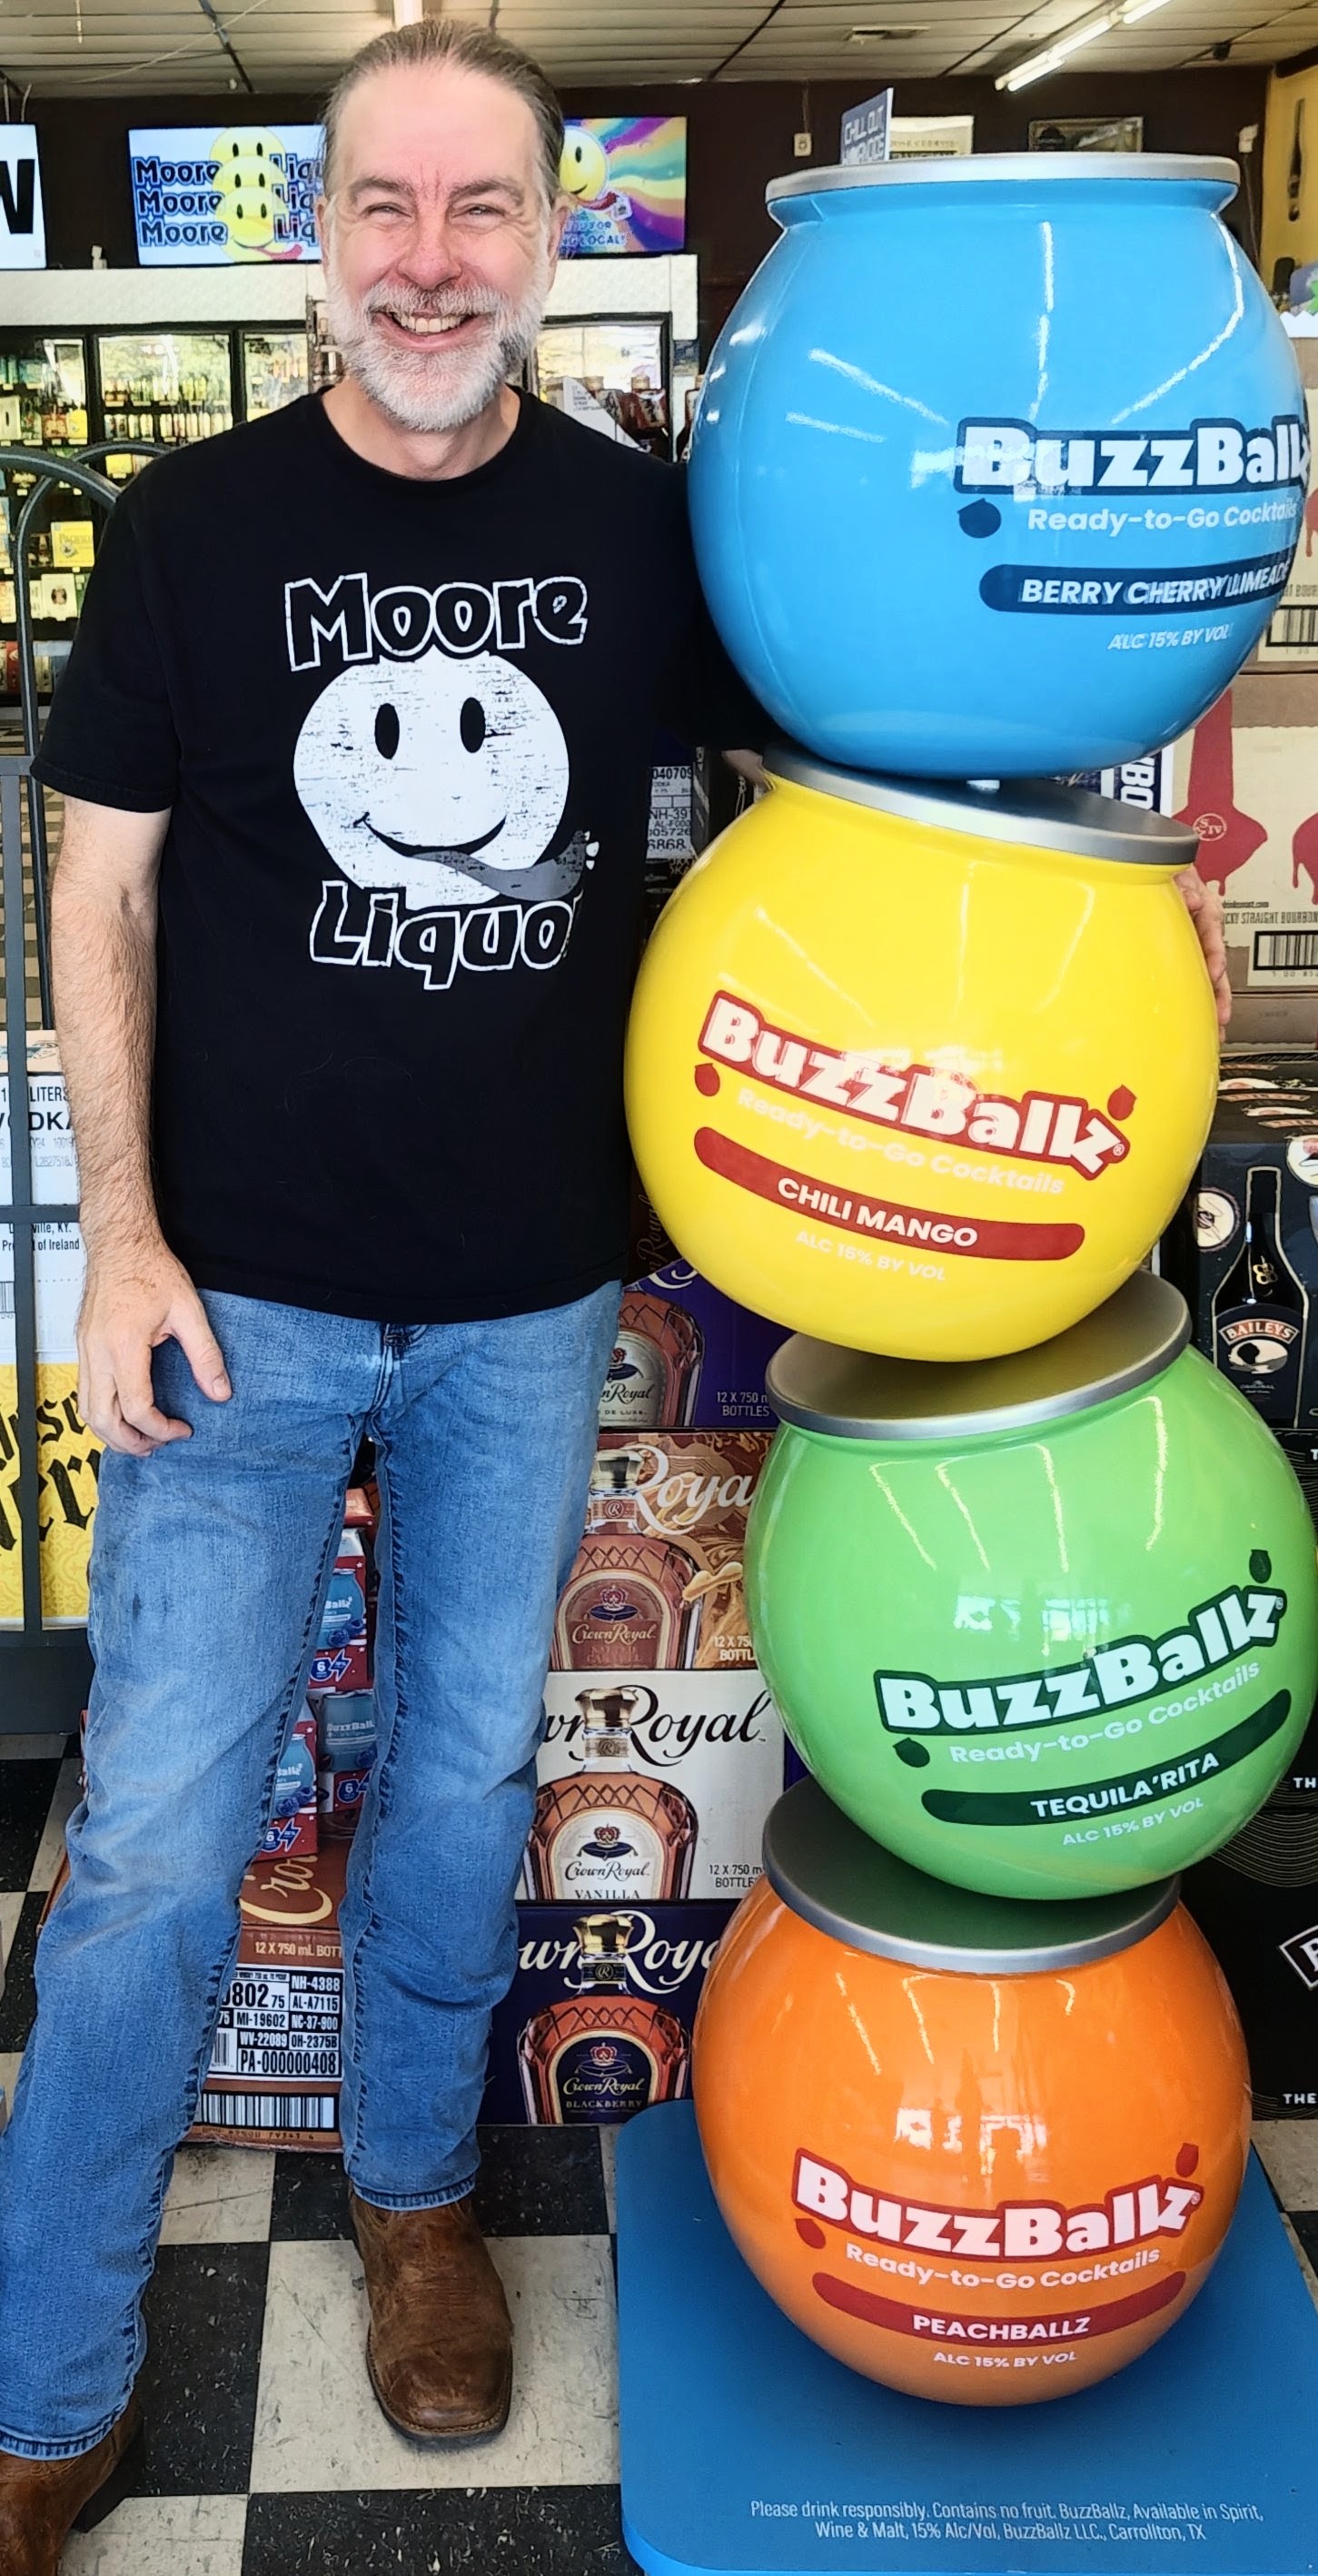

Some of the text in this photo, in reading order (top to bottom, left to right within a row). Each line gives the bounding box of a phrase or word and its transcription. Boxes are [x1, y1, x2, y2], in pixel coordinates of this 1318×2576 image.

[133, 156, 223, 186] Moore
[135, 187, 226, 217] Moore
[138, 221, 227, 247] Moore
[1027, 506, 1220, 537] Ready-to-Go
[1021, 580, 1120, 604] BERRY
[1126, 576, 1226, 604] CHERRY
[284, 572, 588, 671] Moore
[1107, 624, 1234, 649] ALC 15% BY VOL
[738, 1087, 1065, 1194] Ready-to-Go Cocktails
[778, 1177, 978, 1247] CHILI MANGO
[38, 1240, 46, 1250] of
[49, 1238, 80, 1250] Ireland
[795, 1230, 946, 1282] ALC 15% BY VOL
[1226, 1322, 1294, 1339] BAILEYS
[603, 1382, 655, 1404] Royal
[717, 1392, 728, 1402] 12
[729, 1392, 737, 1402] X
[740, 1392, 759, 1402] 750
[722, 1405, 770, 1417] BOTTLES
[621, 1443, 755, 1535] Roya
[572, 1622, 656, 1645] Crown Royal
[715, 1635, 725, 1648] 12
[727, 1635, 736, 1648] X
[719, 1649, 755, 1661] BOTTL
[317, 1661, 326, 1671] 6
[948, 1661, 1260, 1764] Ready-to-Go Cocktails
[1030, 1752, 1220, 1818] TEQUILA'RITA
[1062, 1797, 1204, 1846] ALC 15% BY VOL
[565, 1861, 649, 1881] Crown Royal
[709, 1865, 719, 1875] 12
[722, 1865, 729, 1875] X
[732, 1864, 750, 1875] 750
[715, 1877, 757, 1888] BOTTLE
[575, 1889, 640, 1899] VANILLA
[255, 1942, 342, 1958] 12 X 750 mL BOTT
[291, 1975, 340, 1992] NH-4388
[272, 1995, 285, 2008] 75
[292, 1995, 338, 2011] AL-A7115
[236, 2012, 285, 2028] MI-19602
[291, 2014, 338, 2030] NC-37-900
[240, 2031, 337, 2048] WV-22089 OH-2375B
[241, 2049, 336, 2075] PA-000000408
[562, 2077, 645, 2095] Crown Royal
[566, 2100, 642, 2108] BLACKBERRY
[1283, 2093, 1317, 2105] THE
[846, 2244, 1161, 2289] Ready-to-Go Cocktails
[913, 2314, 1091, 2341] PEACHBALLZ
[933, 2350, 1077, 2369] ALC 15% BY VOL
[751, 2501, 798, 2517] Please
[801, 2501, 839, 2517] drink
[843, 2502, 930, 2522] responsibly.
[932, 2502, 996, 2519] Contains
[1000, 2507, 1019, 2519] no
[1058, 2502, 1131, 2521] BuzzBallz,
[1133, 2503, 1199, 2520] Available
[1202, 2504, 1218, 2520] in
[1220, 2504, 1263, 2522] Spirit,
[815, 2522, 853, 2538] Wine
[857, 2522, 868, 2538] &
[872, 2522, 908, 2540] Malt,
[911, 2522, 941, 2539] 15%
[945, 2522, 1000, 2541] Alc/Vol,
[1004, 2522, 1072, 2540] BuzzBallz
[1108, 2523, 1185, 2541] Carrollton,
[1187, 2524, 1206, 2540] TX
